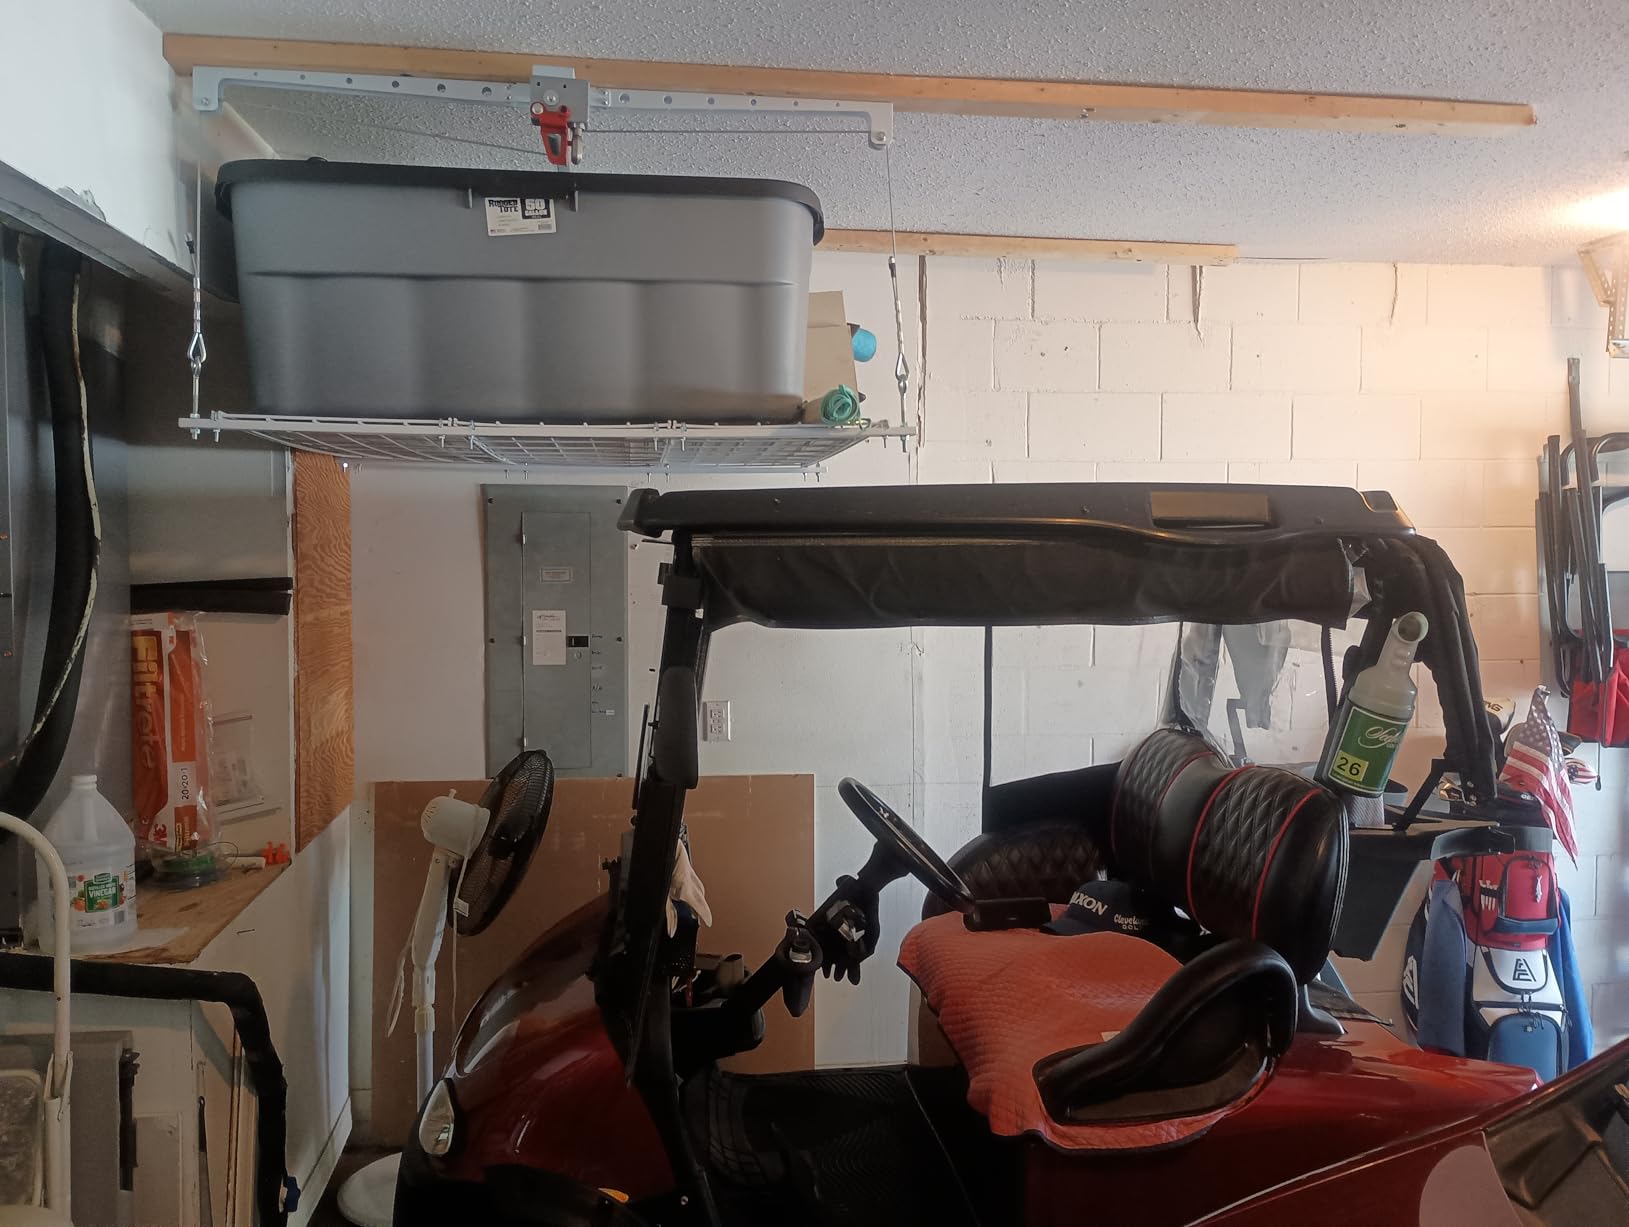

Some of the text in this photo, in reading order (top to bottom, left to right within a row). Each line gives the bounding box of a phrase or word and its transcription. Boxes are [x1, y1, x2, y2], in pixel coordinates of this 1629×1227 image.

[525, 198, 545, 209] 50
[131, 636, 159, 769] Filtrete
[1336, 756, 1362, 776] 26
[88, 887, 117, 898] VINEGAR
